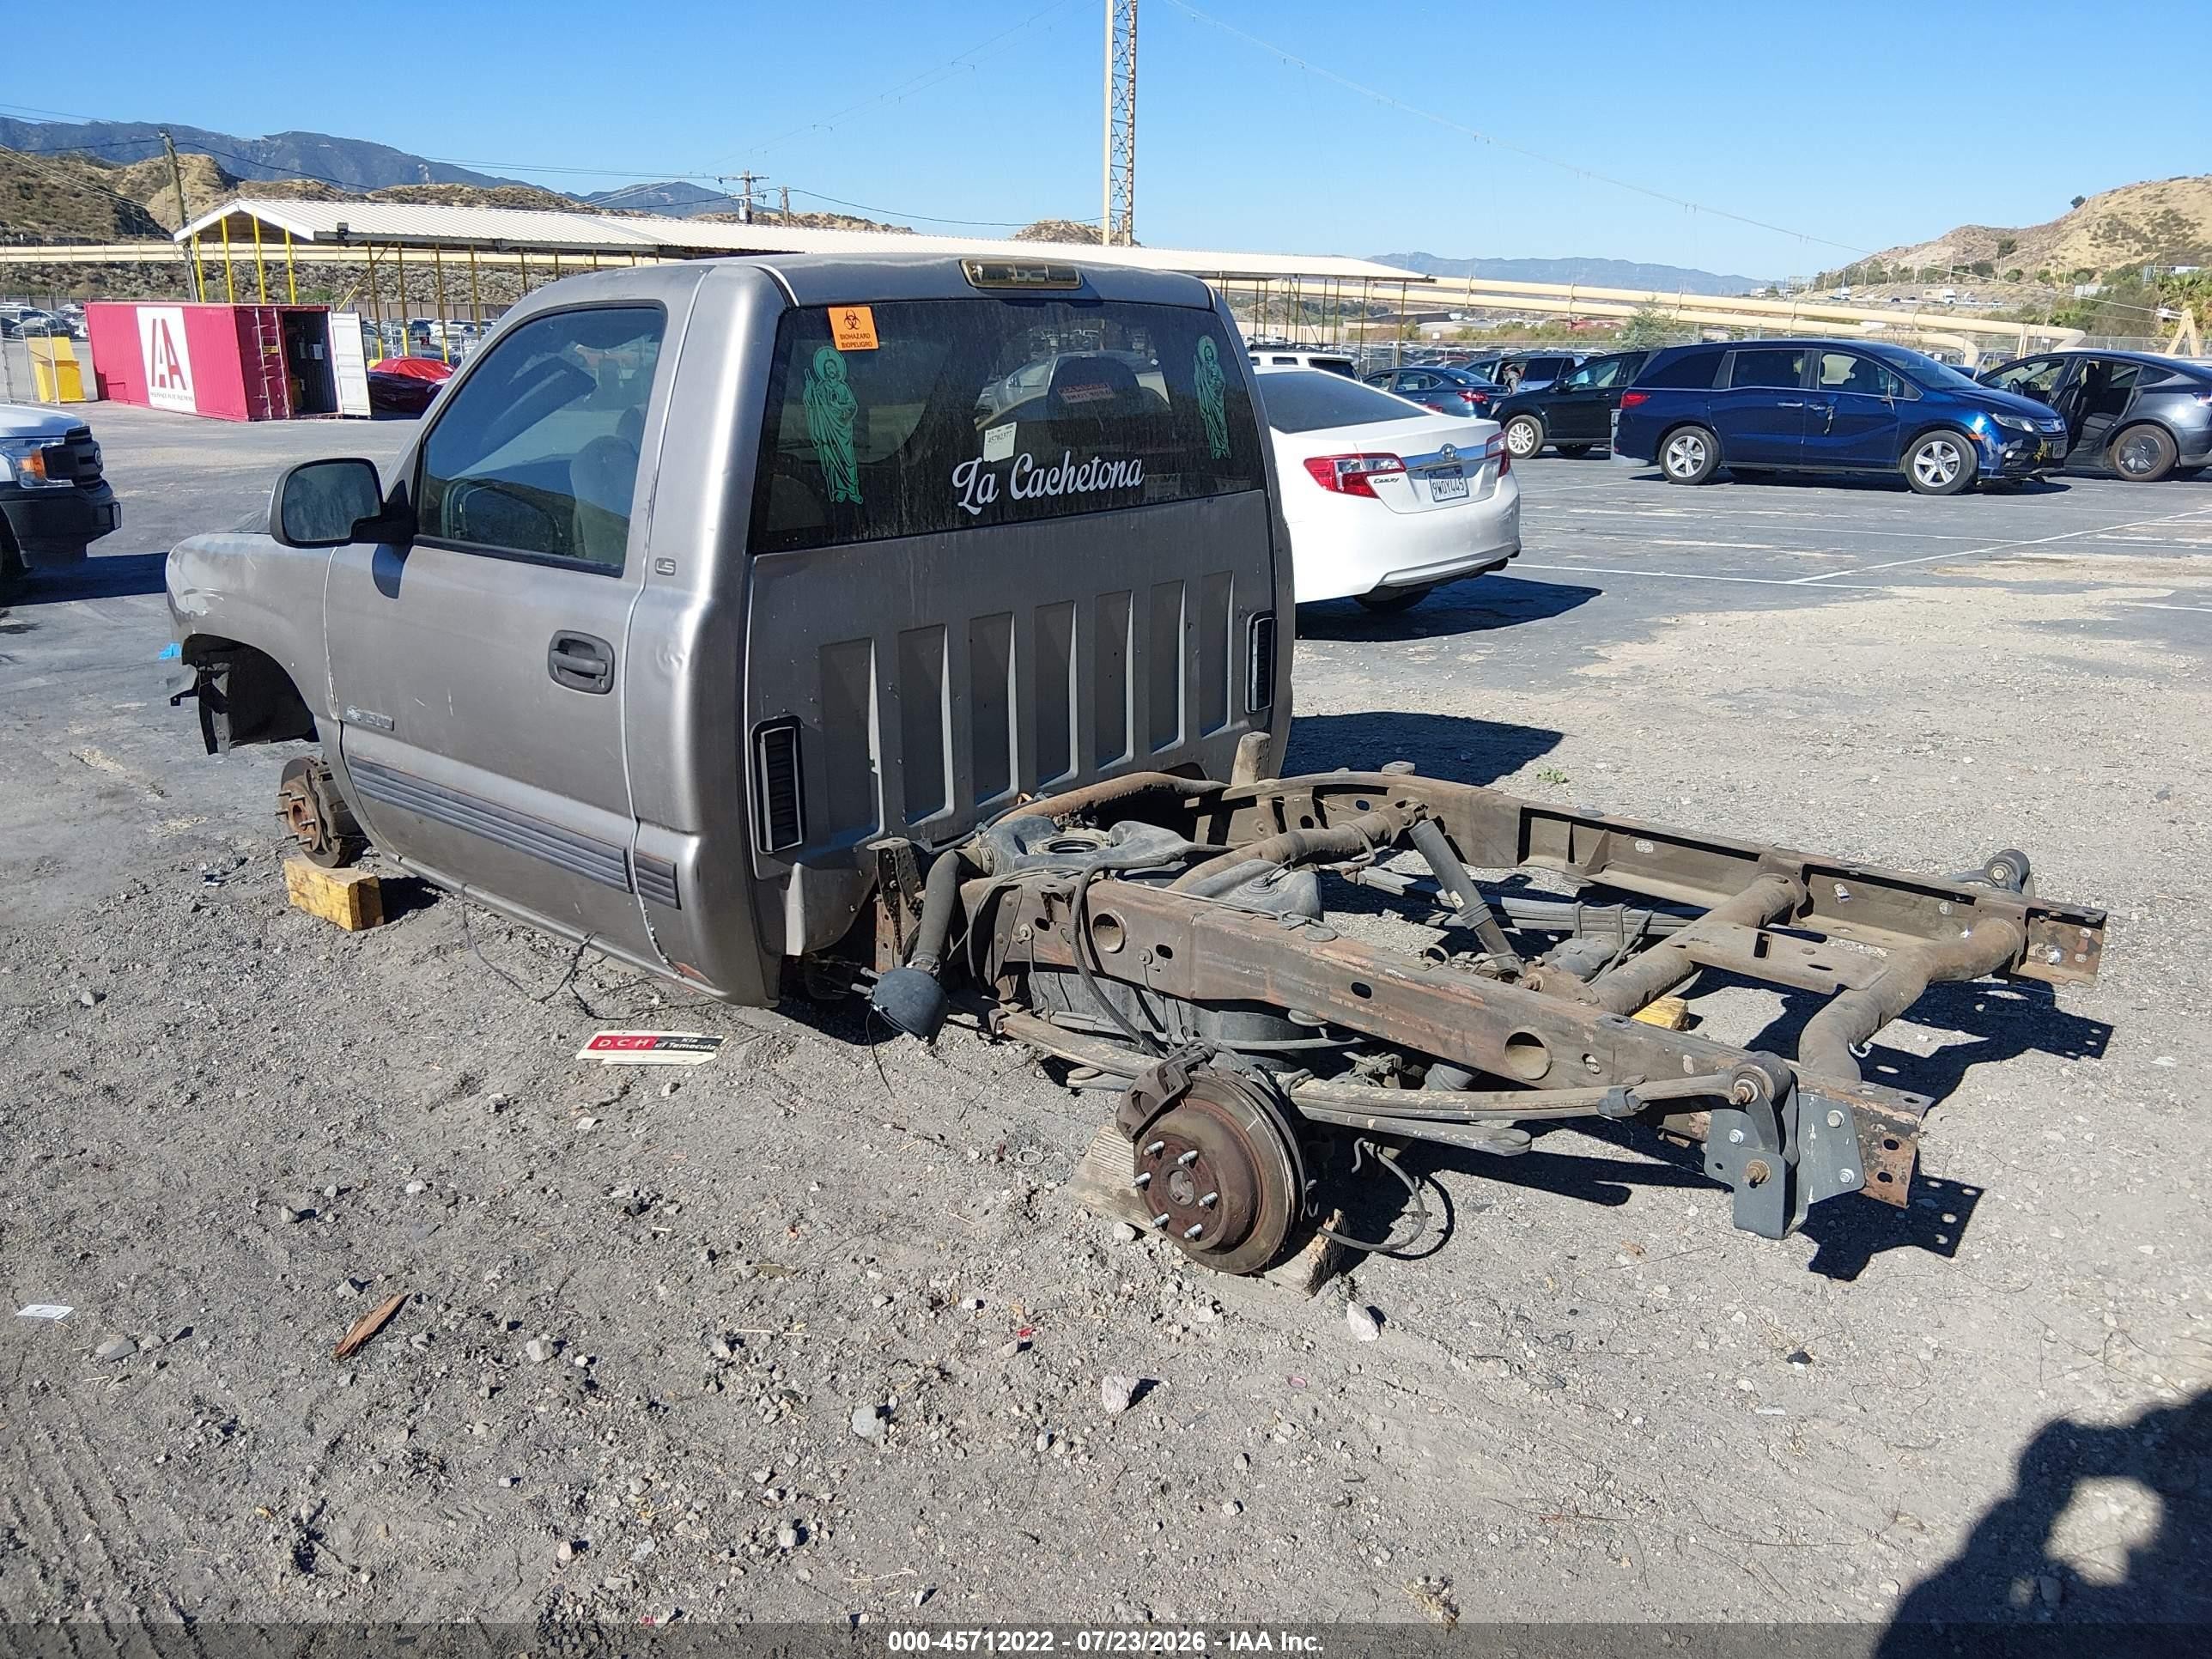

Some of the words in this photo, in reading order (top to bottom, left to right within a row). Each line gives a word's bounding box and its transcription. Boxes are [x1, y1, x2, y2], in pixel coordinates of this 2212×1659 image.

[951, 457, 1000, 515] La
[1010, 450, 1146, 501] Cachetona
[656, 560, 675, 573] LS
[669, 1042, 716, 1050] Temecula
